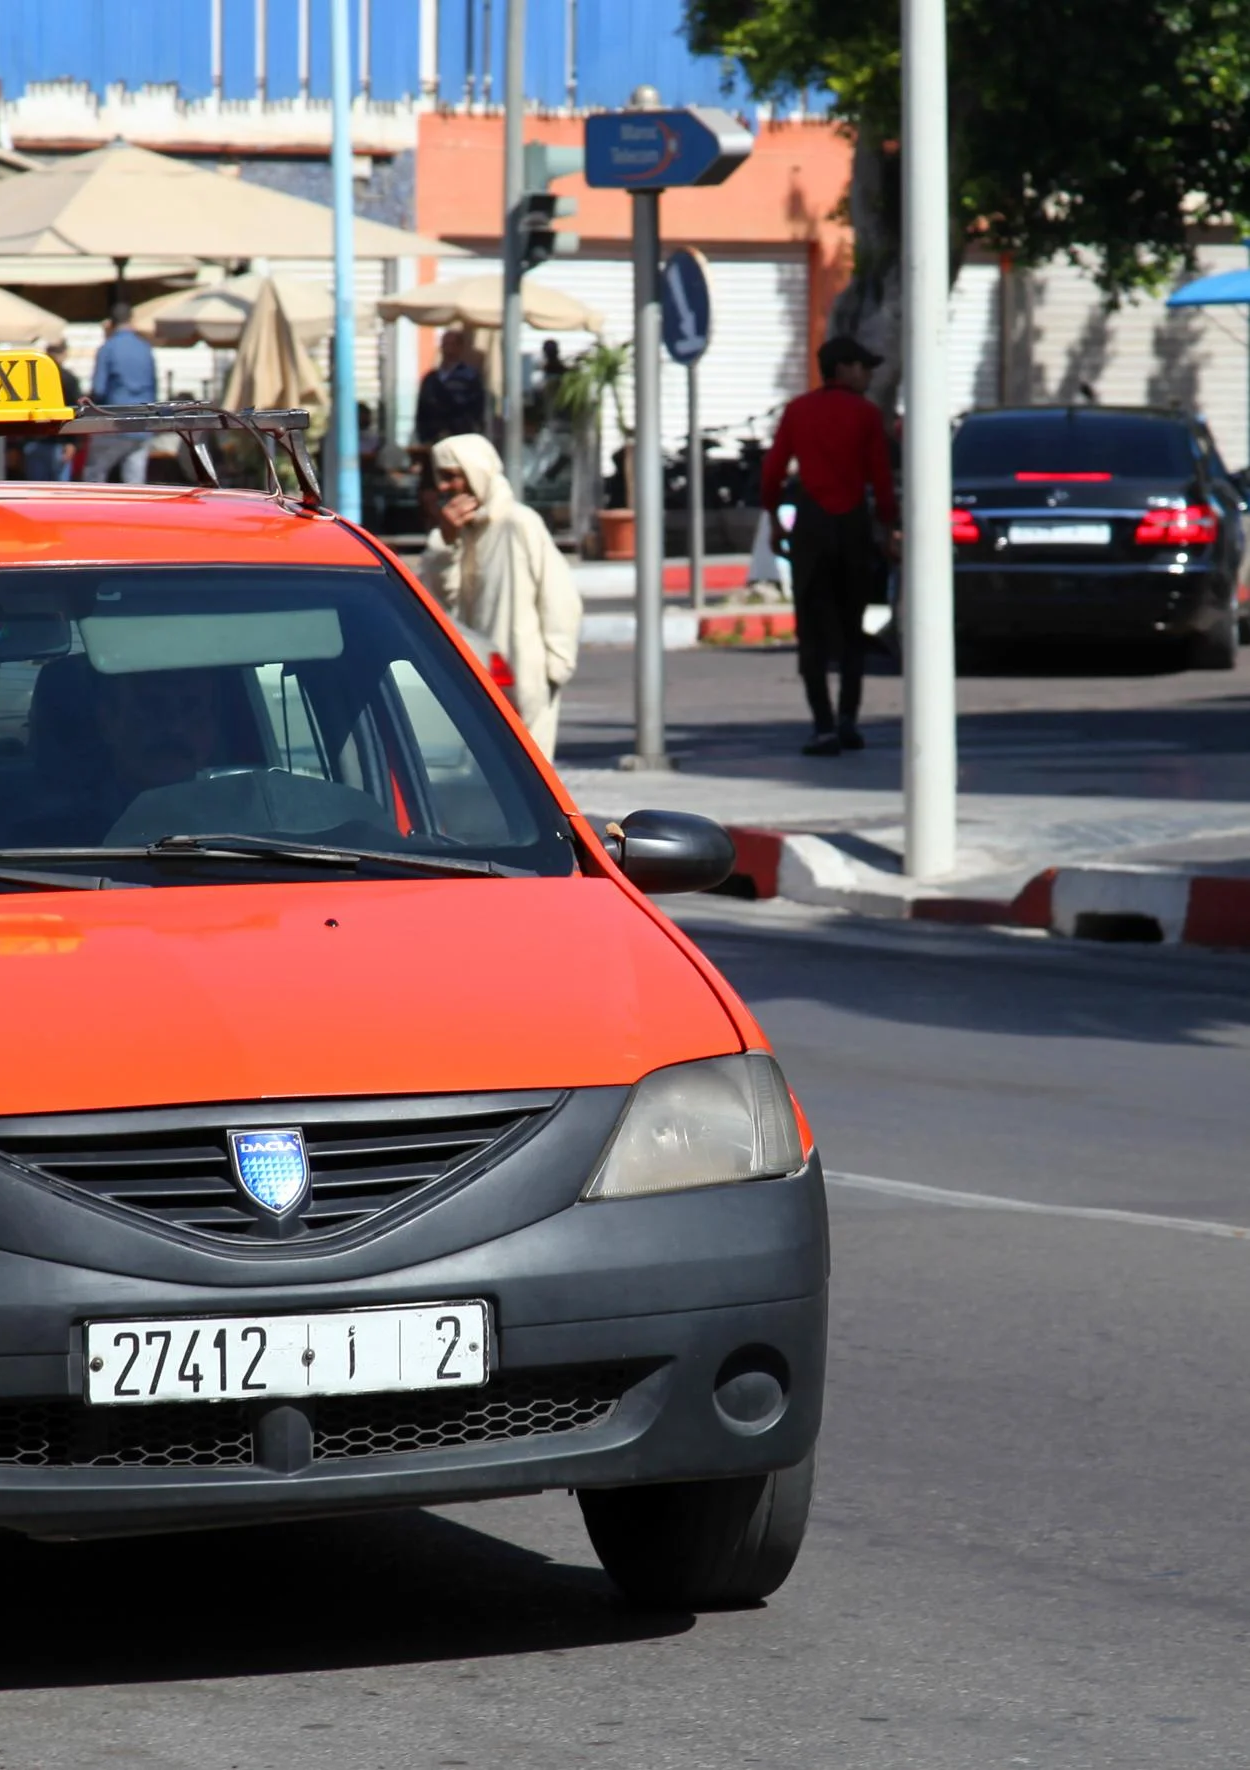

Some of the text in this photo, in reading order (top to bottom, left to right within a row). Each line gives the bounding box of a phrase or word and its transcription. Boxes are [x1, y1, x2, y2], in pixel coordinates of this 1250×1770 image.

[240, 1141, 298, 1153] DACIA
[113, 1326, 267, 1397] 27412
[435, 1316, 462, 1379] 2
